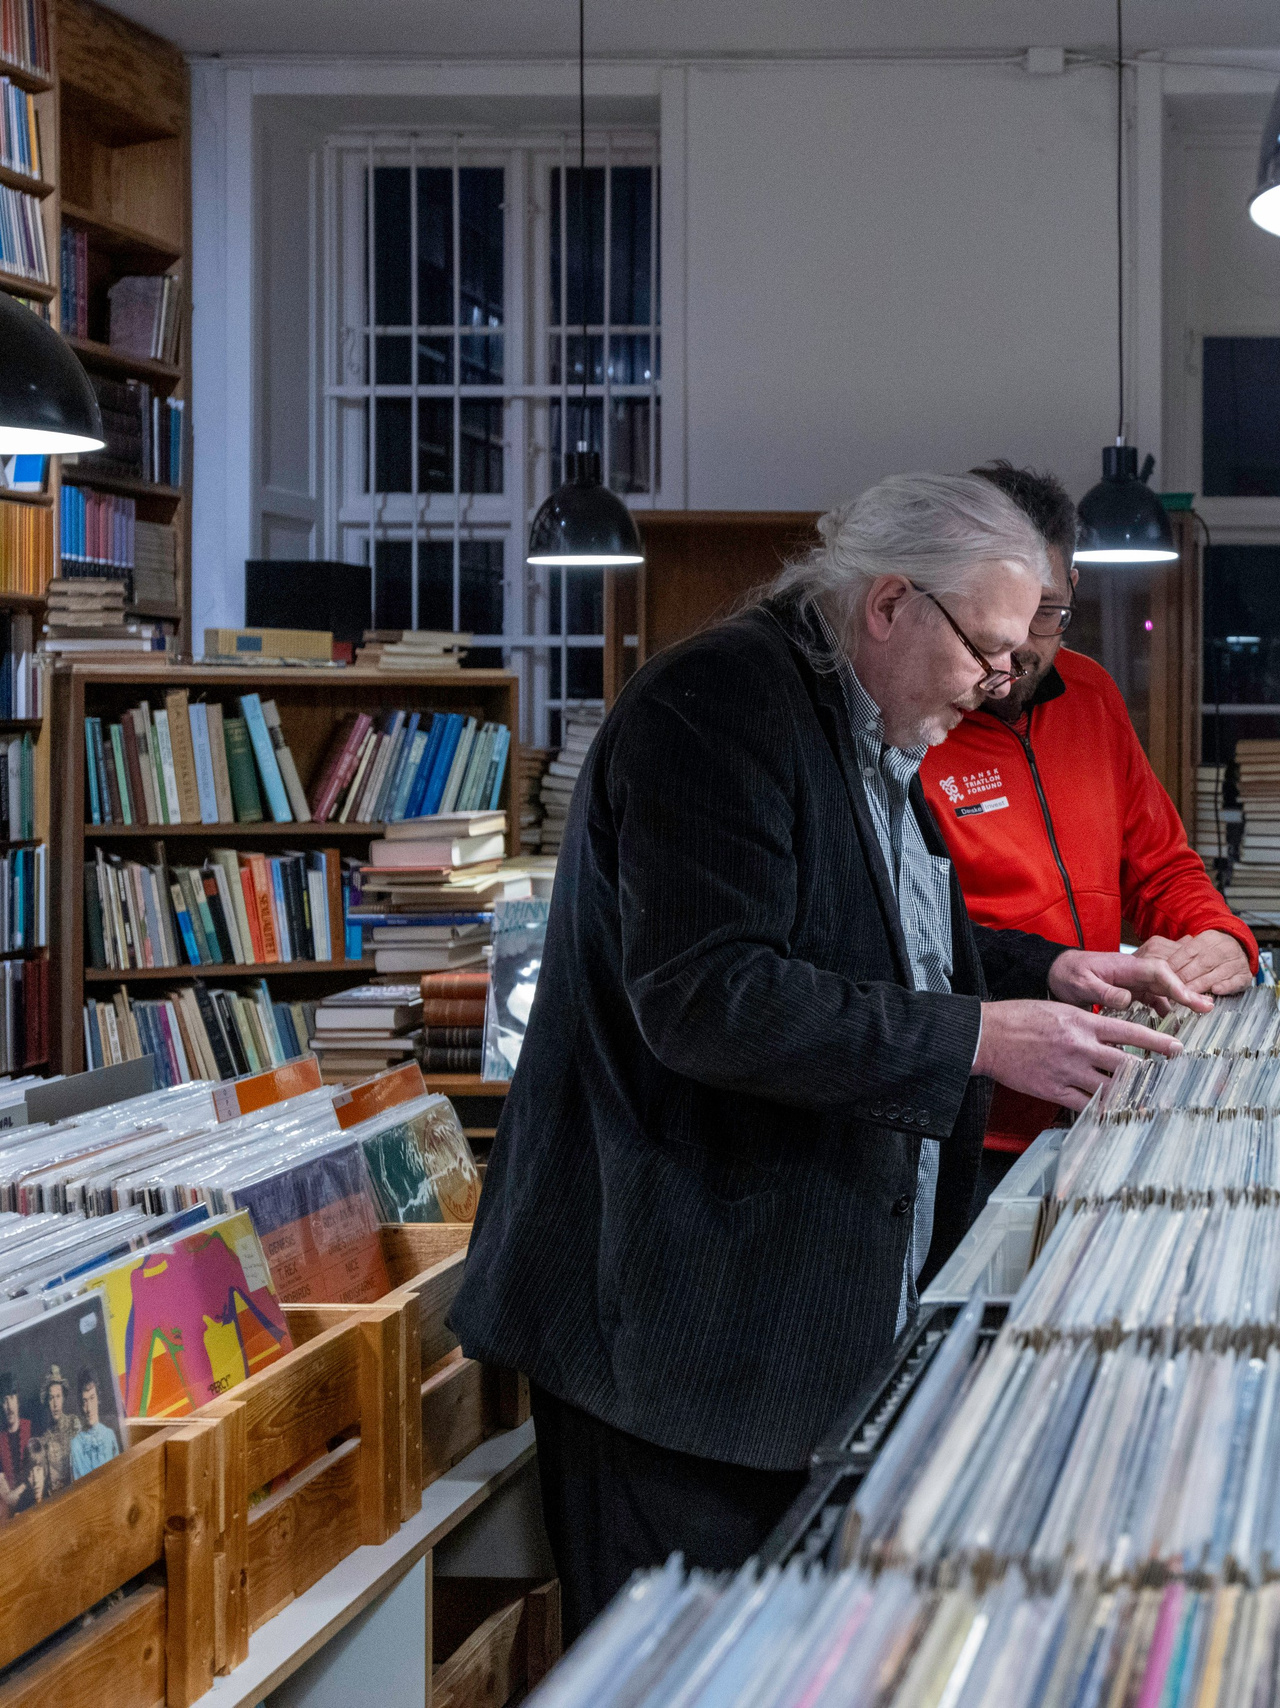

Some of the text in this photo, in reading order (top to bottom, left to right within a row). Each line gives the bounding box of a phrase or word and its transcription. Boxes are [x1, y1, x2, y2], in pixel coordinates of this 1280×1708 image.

[962, 768, 998, 782] DANSK
[965, 774, 1000, 788] TRIATLON
[967, 781, 1002, 794] FORBUND
[960, 800, 1005, 814] Danske Invest
[268, 1234, 296, 1254] GENESIS
[277, 1264, 298, 1280] T.REX
[344, 1258, 360, 1272] NICE
